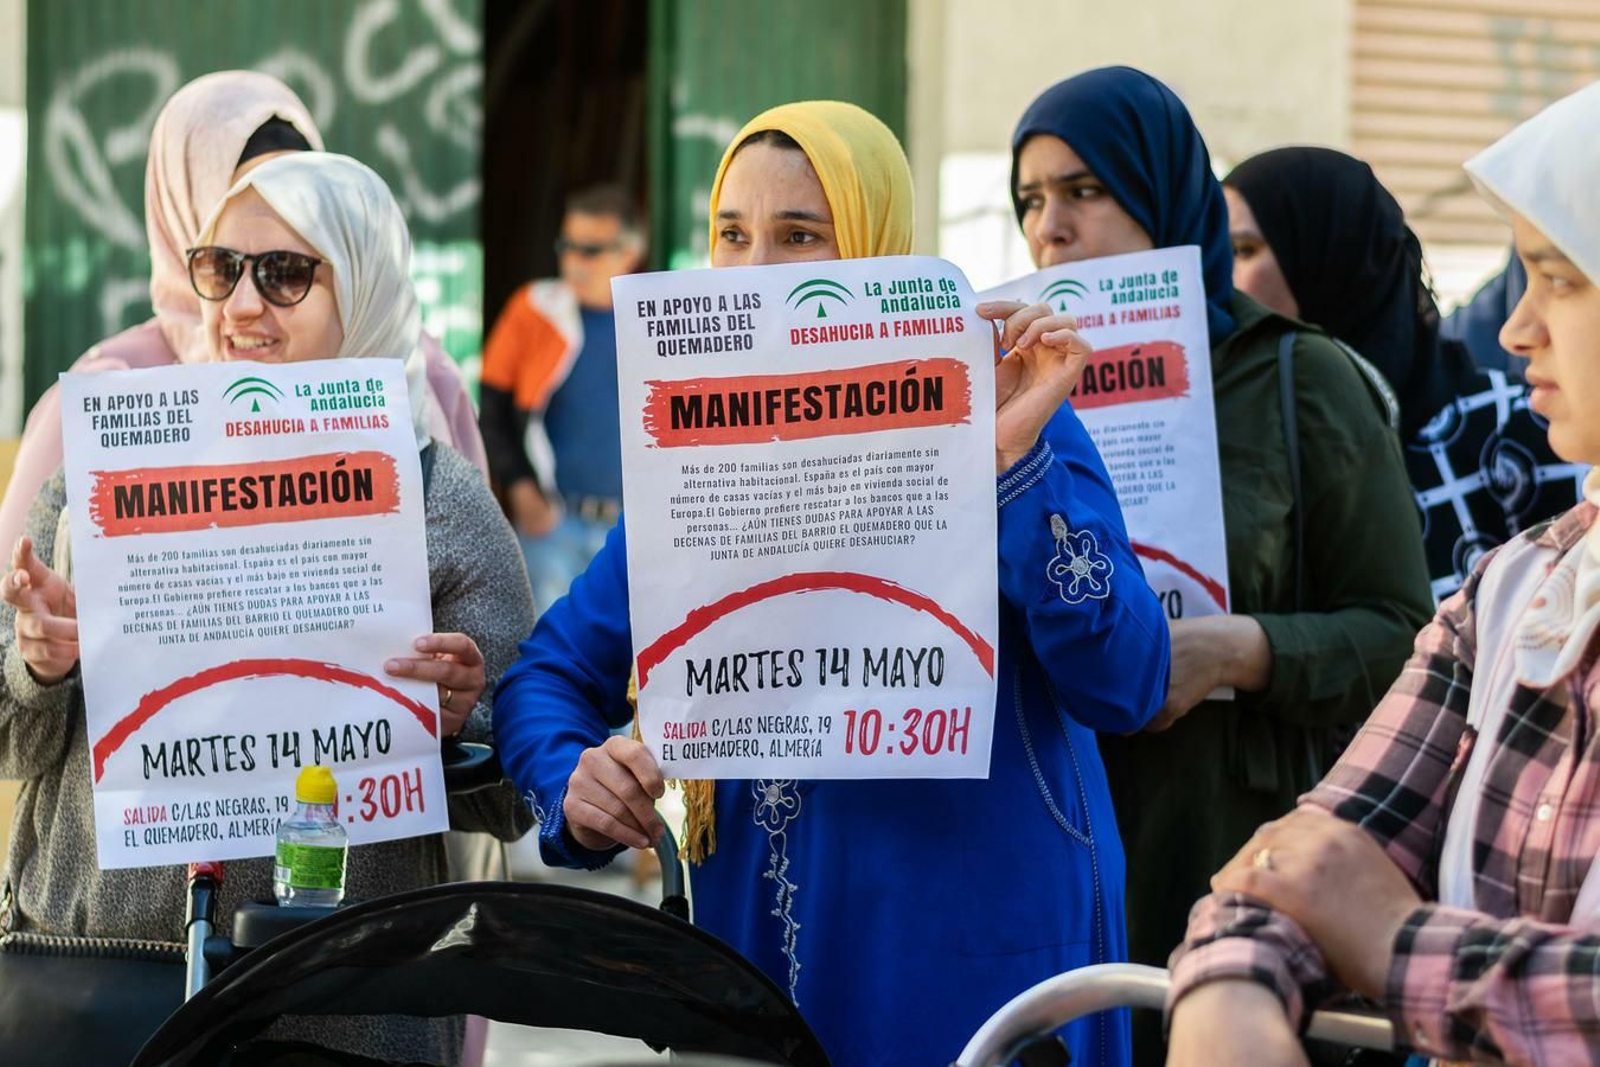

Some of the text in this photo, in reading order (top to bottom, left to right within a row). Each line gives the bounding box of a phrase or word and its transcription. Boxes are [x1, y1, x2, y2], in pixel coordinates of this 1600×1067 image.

[864, 277, 957, 297] La Junta de
[1100, 270, 1178, 292] La Junta de
[636, 292, 762, 318] EN APOYO A LAS
[880, 294, 962, 314] Andalucía
[1109, 312, 1116, 325] A
[1121, 305, 1181, 323] FAMILIAS
[646, 312, 756, 338] FAMILIAS DEL
[790, 316, 965, 346] DESAHUCIA A FAMILIAS
[656, 333, 753, 358] QUEMADERO
[83, 389, 199, 413] EN APOYO A LAS
[294, 377, 384, 398] La Junta de
[670, 365, 944, 430] MANIFESTACIÓN
[310, 394, 386, 412] Andalucía
[92, 408, 193, 431] FAMILIAS DEL
[225, 414, 390, 438] DESAHUCIA A FAMILIAS
[100, 426, 191, 449] QUEMADERO
[681, 447, 940, 475] Más de 200 familias son desahuciadas diariamente sin
[114, 458, 374, 520] MANIFESTACIÓN
[670, 475, 949, 505] número de casas vacías y el más bajo en vivienda social de
[683, 463, 934, 490] alternativa habitacional. España es el país con mayor
[670, 490, 949, 520] Europa.El Gobierno prefiere rescatar a los bancos que a las
[686, 504, 935, 535] personas... ¿AÚN TIENES DUDAS PARA APOYAR A LAS
[673, 519, 948, 548] DECENAS DE FAMILIAS DEL BARRIO EL QUEMADERO QUE LA
[126, 537, 372, 564] Más de 200 familias son desahuciadas diariamente sin
[710, 549, 739, 561] JUNTA
[742, 547, 755, 559] DE
[812, 537, 847, 552] QUIERE
[849, 534, 916, 548] DESAHUCIAR?
[186, 590, 370, 617] ¿AÚN TIENES DUDAS PARA APOYAR A LAS
[122, 603, 384, 635] DECENAS DE FAMILIAS DEL BARRIO EL QUEMADERO QUE LA
[158, 633, 186, 646] JUNTA
[188, 632, 200, 643] DE
[257, 624, 290, 638] QUIERE
[292, 618, 355, 634] DESAHUCIAR?
[685, 646, 945, 697] MARTES 14 MAYO
[663, 714, 832, 741] SALIDA C/LAS NEGRAS, 19
[843, 706, 972, 756] 10:30H
[140, 718, 392, 781] MARTES 14 MAYO
[662, 743, 678, 762] EL
[681, 738, 765, 761] QUEMADERO,
[331, 767, 425, 824] :30H
[123, 795, 289, 826] SALIDA C/LAS NEGRAS, 19
[124, 829, 140, 848] EL
[143, 821, 224, 846] QUEMADERO,
